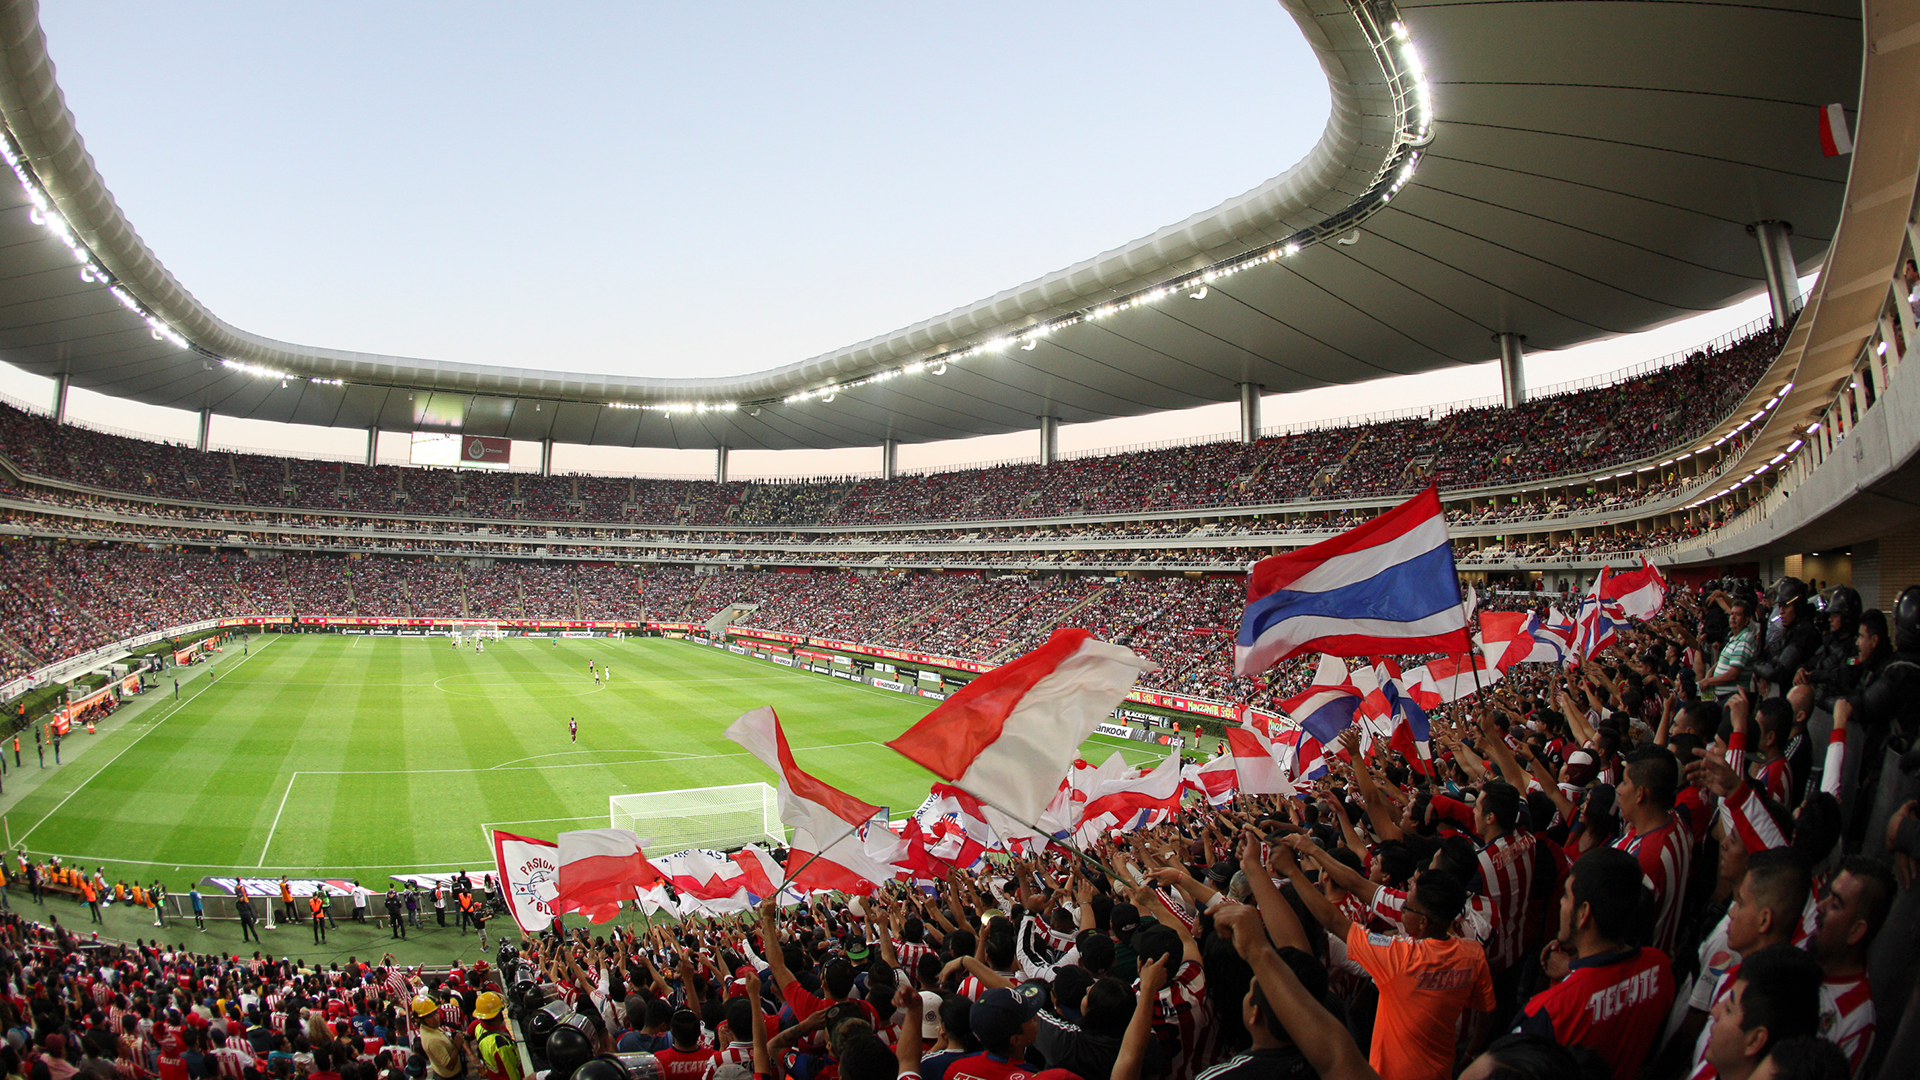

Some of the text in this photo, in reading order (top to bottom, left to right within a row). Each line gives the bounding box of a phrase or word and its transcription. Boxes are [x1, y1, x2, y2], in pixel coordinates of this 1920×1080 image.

[1187, 701, 1219, 717] MANZANITA
[1095, 726, 1127, 737] ANKOOK
[520, 857, 556, 876] PASION
[1415, 966, 1474, 990] TECATE
[1584, 964, 1661, 1025] TECATE
